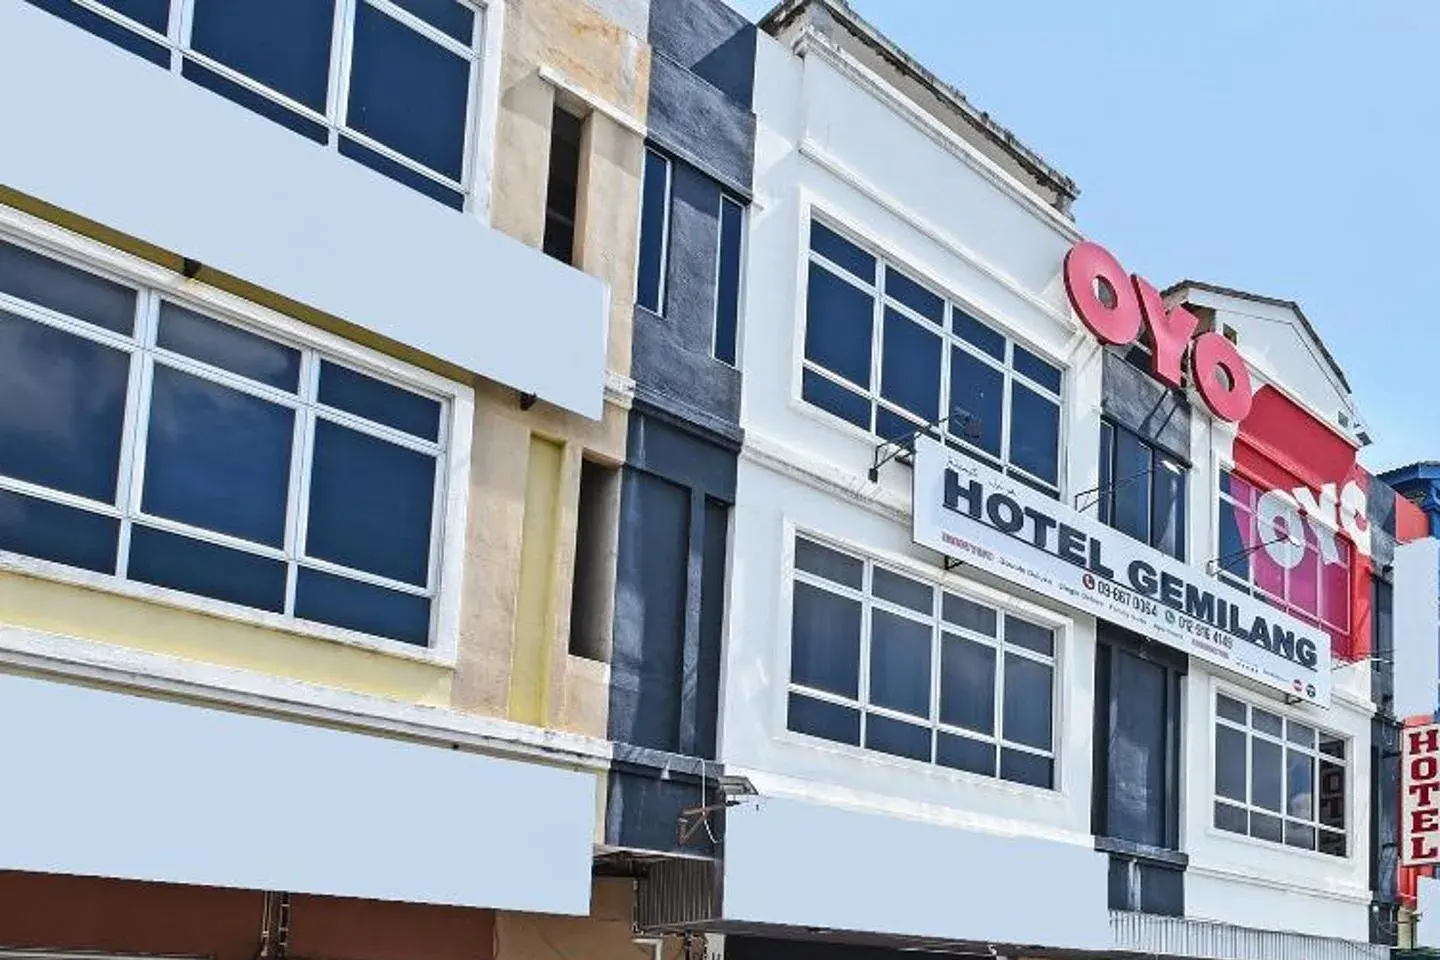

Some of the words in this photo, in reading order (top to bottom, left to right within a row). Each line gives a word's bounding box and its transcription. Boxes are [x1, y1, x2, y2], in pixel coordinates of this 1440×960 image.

[1063, 240, 1253, 423] OYO
[944, 467, 1114, 579] HOTEL
[1128, 560, 1318, 668] GEMILANG
[1256, 480, 1372, 569] OYO
[1408, 729, 1440, 861] HOTEL
